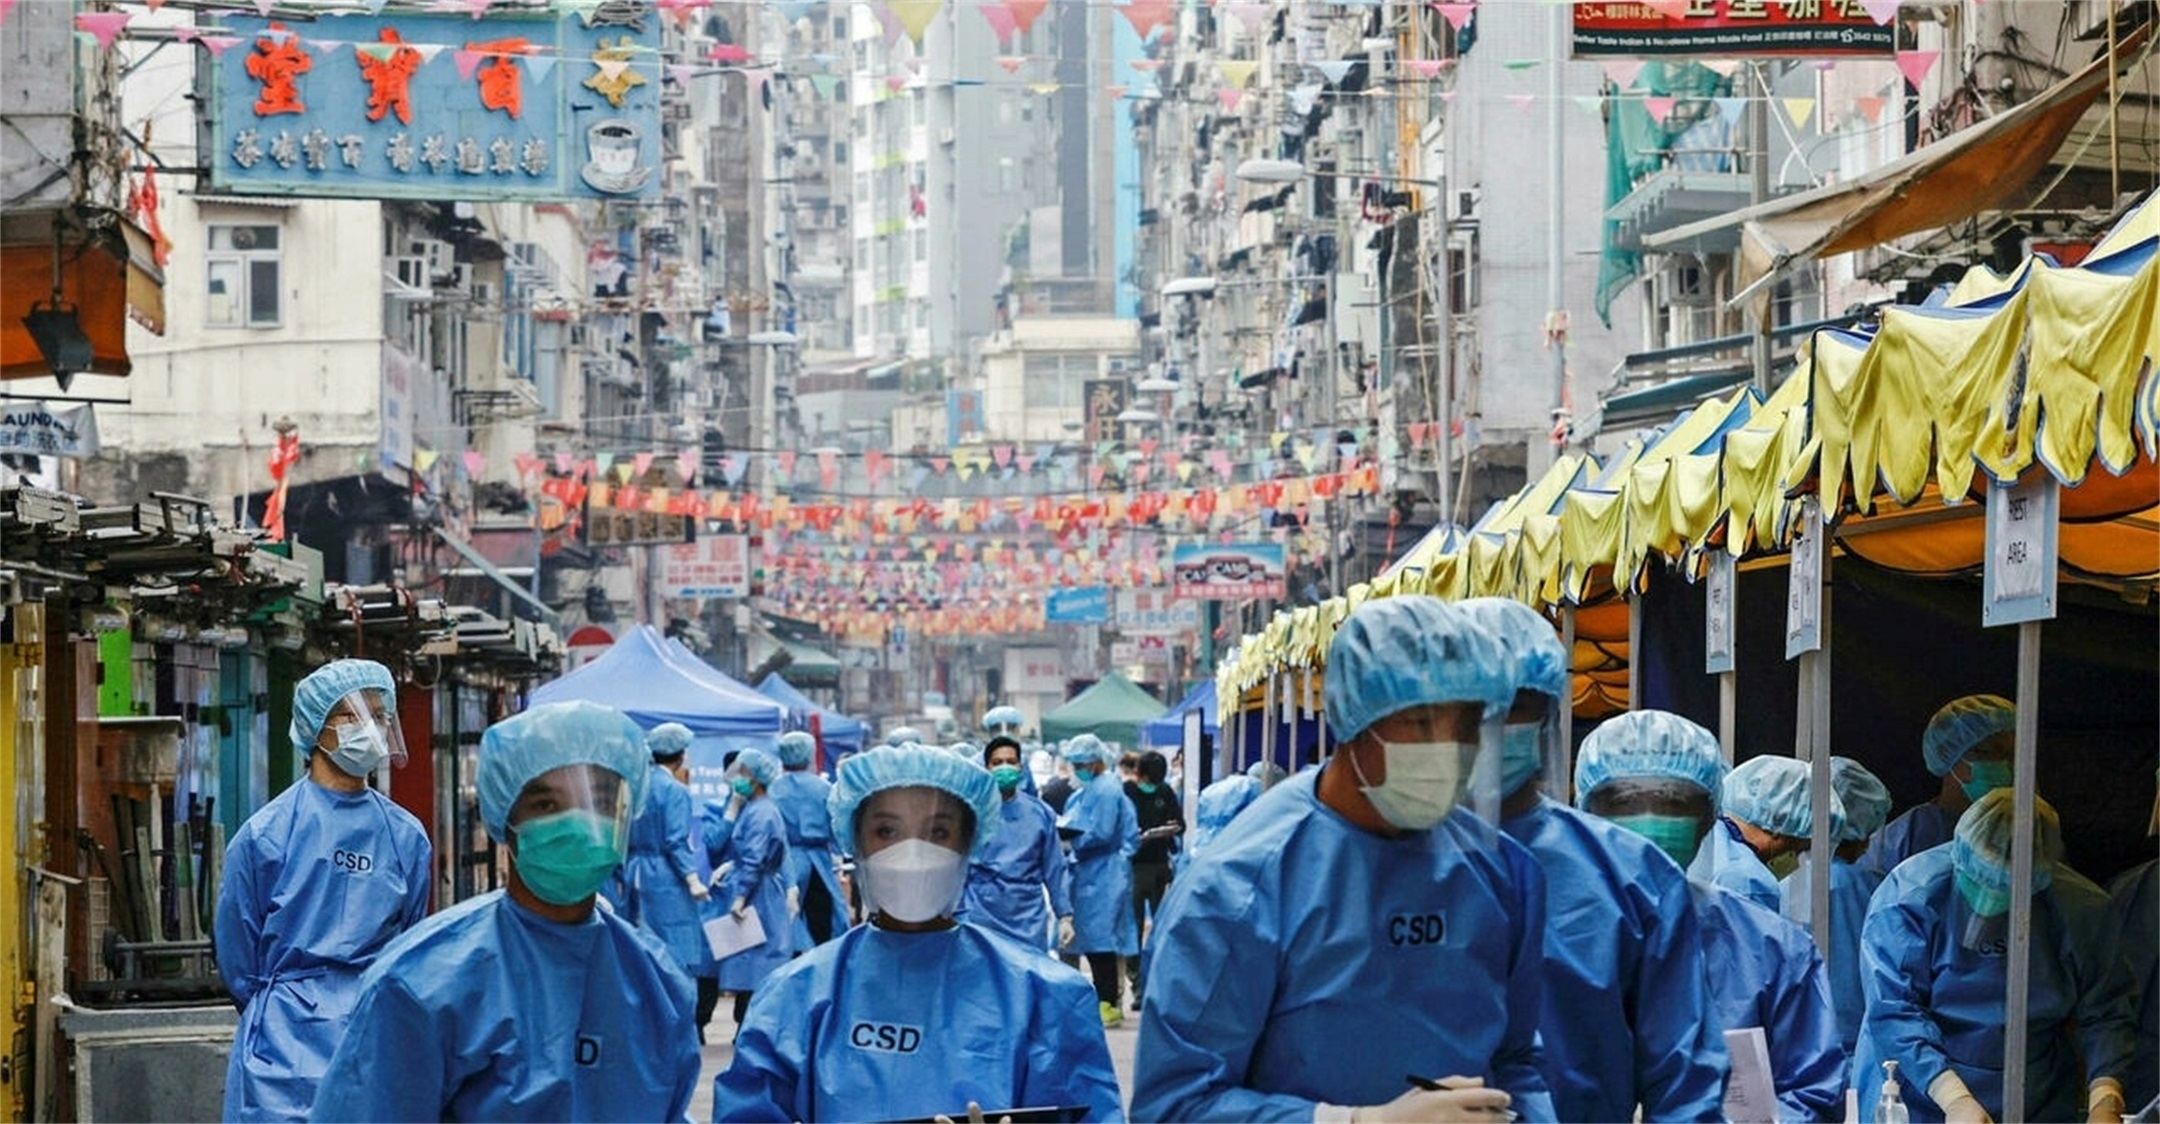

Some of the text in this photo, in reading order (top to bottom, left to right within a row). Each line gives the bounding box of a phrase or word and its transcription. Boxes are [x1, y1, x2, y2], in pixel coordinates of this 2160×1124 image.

[2006, 541, 2028, 565] AREA
[333, 849, 372, 871] CSD
[1390, 914, 1444, 946] CSD
[1979, 937, 2008, 956] CS
[575, 1036, 599, 1066] D
[851, 1022, 921, 1053] CSD
